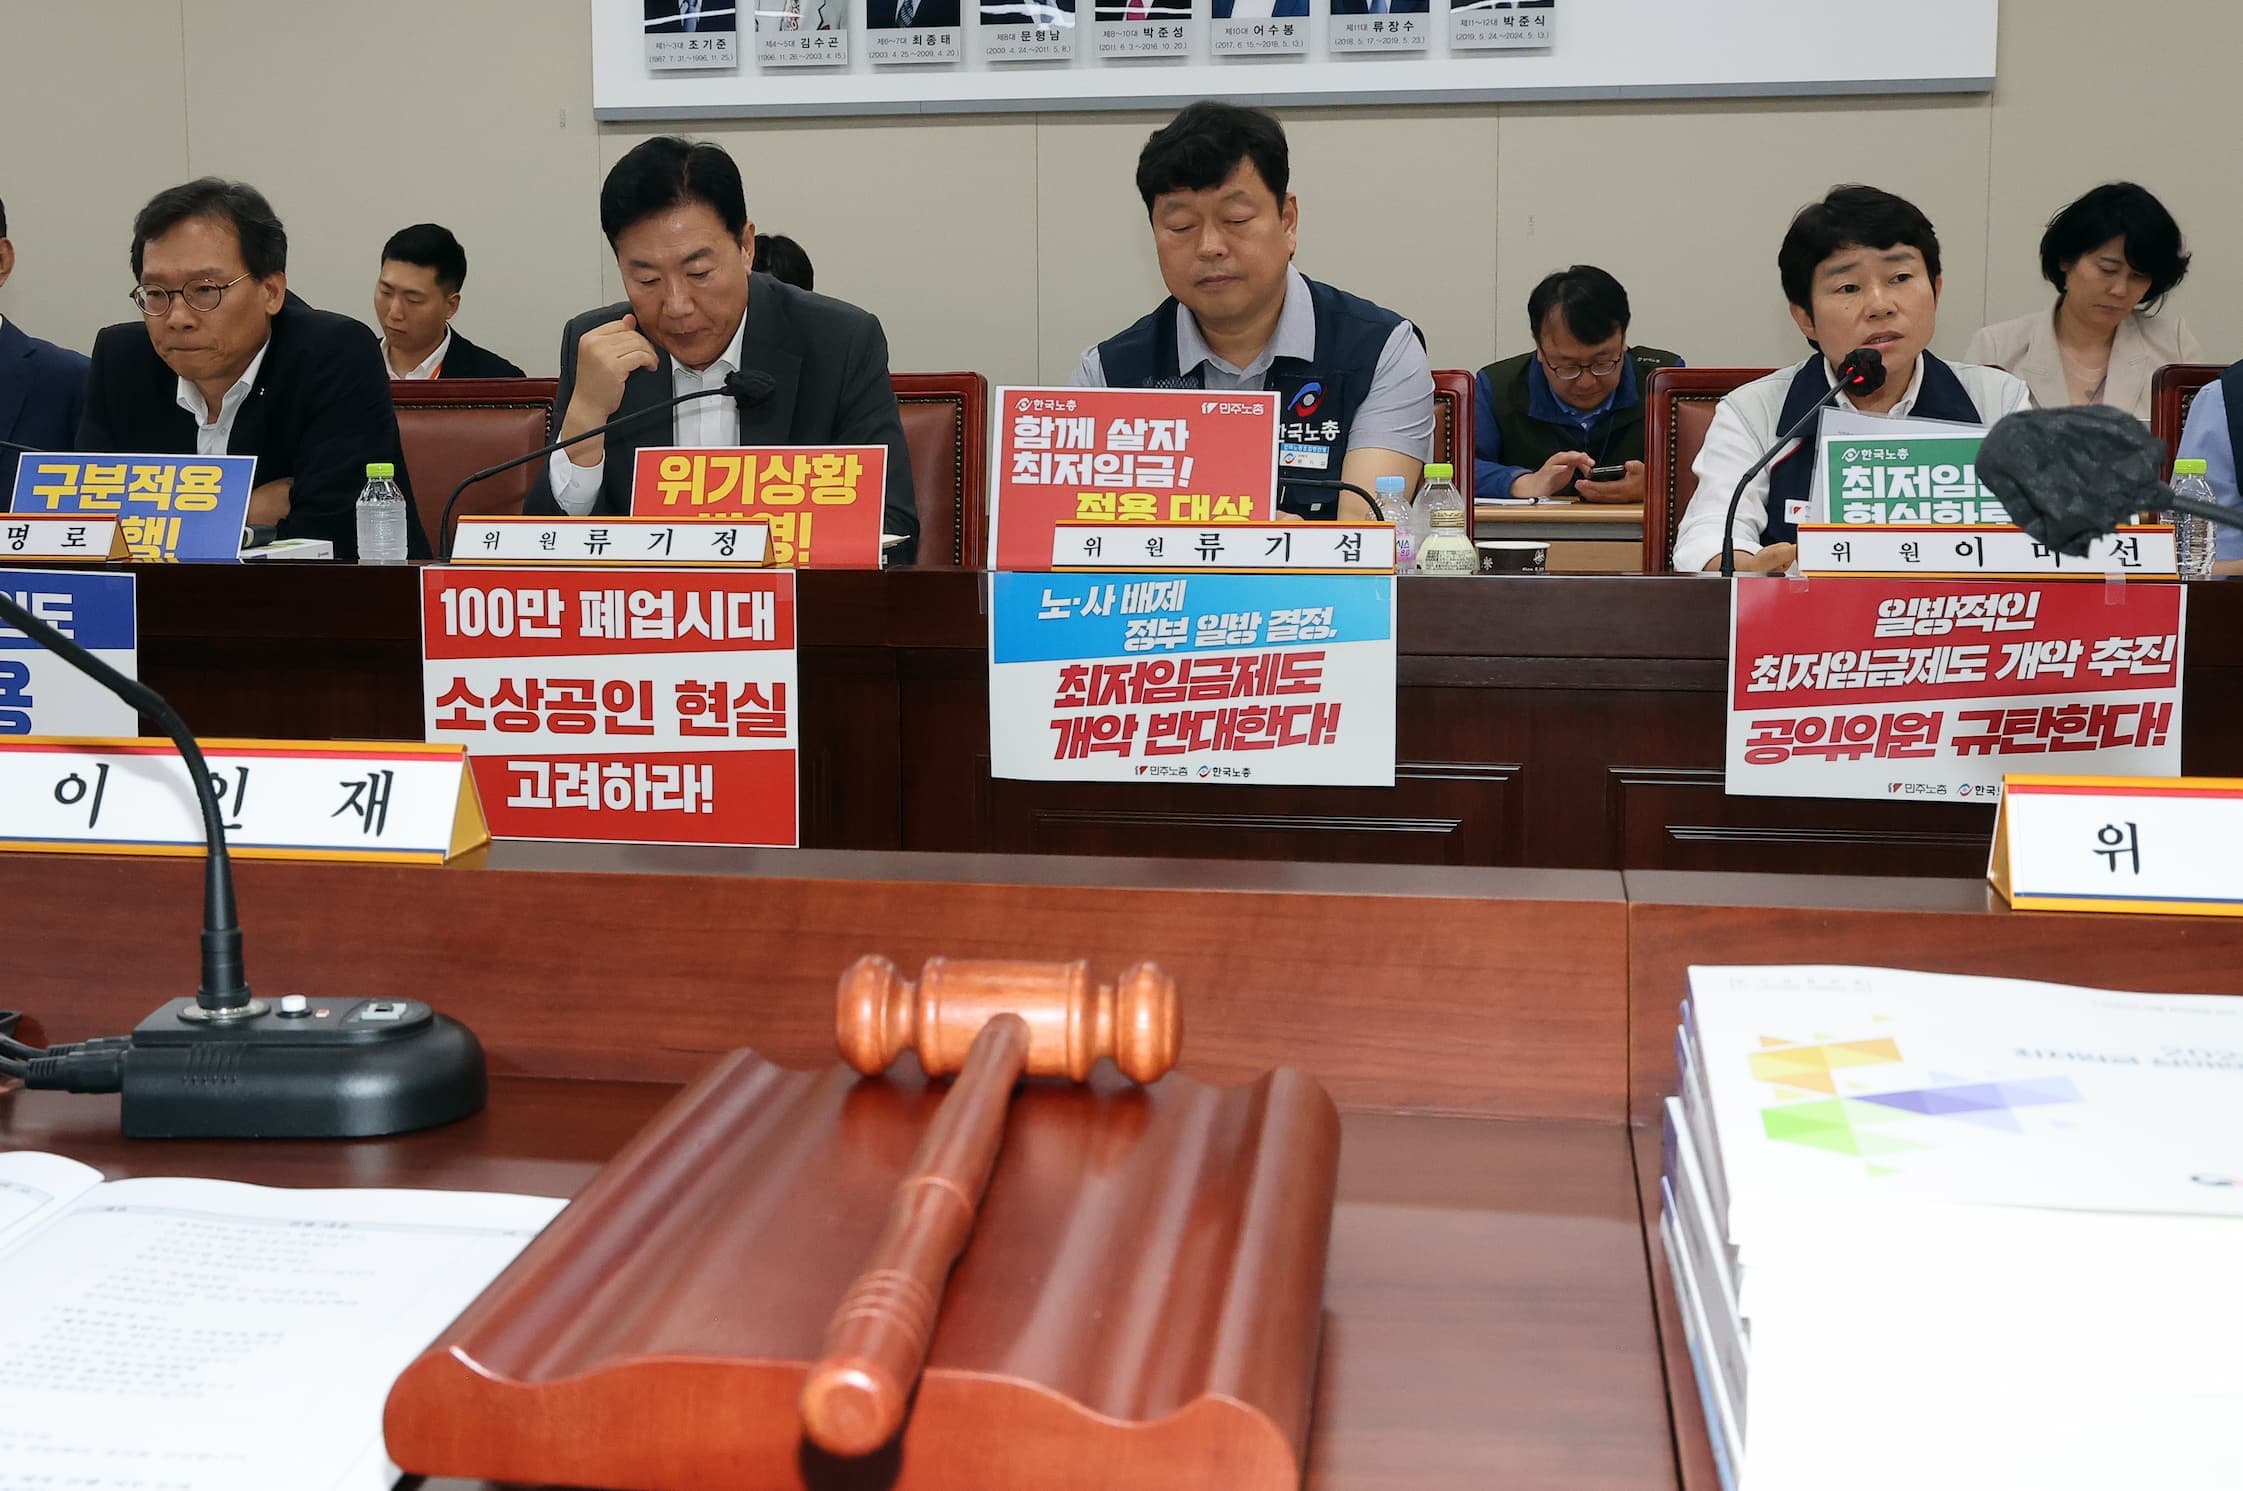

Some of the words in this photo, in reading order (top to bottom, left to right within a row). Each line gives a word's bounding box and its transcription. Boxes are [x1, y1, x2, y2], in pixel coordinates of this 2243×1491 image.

[1020, 30, 1060, 42] 문형남
[1143, 26, 1184, 39] 박준성
[1253, 24, 1294, 36] 어수봉
[1373, 20, 1414, 33] 류장수
[1503, 15, 1545, 28] 박준식
[688, 38, 727, 50] 조기준
[801, 37, 839, 49] 김수곤
[912, 34, 951, 46] 최종태
[1034, 399, 1077, 411] 한국노총
[1219, 403, 1264, 415] 민주노총
[1014, 415, 1096, 450] 함께
[1106, 418, 1190, 451] 살자
[1861, 448, 1909, 460] 한국노총
[657, 453, 863, 506] 위기상황
[1011, 451, 1195, 488] 최저임금!
[1842, 464, 1996, 499] 최저임
[33, 464, 223, 511] 구분적용
[1076, 492, 1158, 521] 적용
[1170, 494, 1253, 521] 대상
[8, 524, 87, 550] 명로
[120, 515, 182, 559] 행!
[583, 528, 738, 557] 류기정
[1194, 532, 1363, 563] 류기섭
[1120, 580, 1187, 613] 배제
[440, 587, 565, 638] 100만
[578, 589, 775, 642] 폐업시대
[1874, 591, 2041, 638] 일방적인
[1124, 617, 1188, 652] 정부
[1194, 611, 1263, 648] 일방
[1746, 644, 1991, 693] 최저임금제도
[1995, 639, 2084, 681] 개악
[2087, 634, 2176, 675] 추진
[1053, 650, 1326, 709] 최저임금제도
[435, 676, 655, 735] 소상공인
[674, 680, 788, 738] 현실
[1049, 712, 1139, 761] 개악
[1143, 702, 1342, 756] 반대한다!
[1743, 711, 1945, 765] 공익위원
[1950, 702, 2174, 757] 규탄한다!
[1150, 765, 1188, 777] 민주노총
[1213, 766, 1251, 778] 한국노총
[507, 760, 714, 814] 고려하라!
[1905, 783, 1947, 795] 민주노총
[1975, 785, 2000, 796] 한국
[2092, 821, 2140, 875] 위
